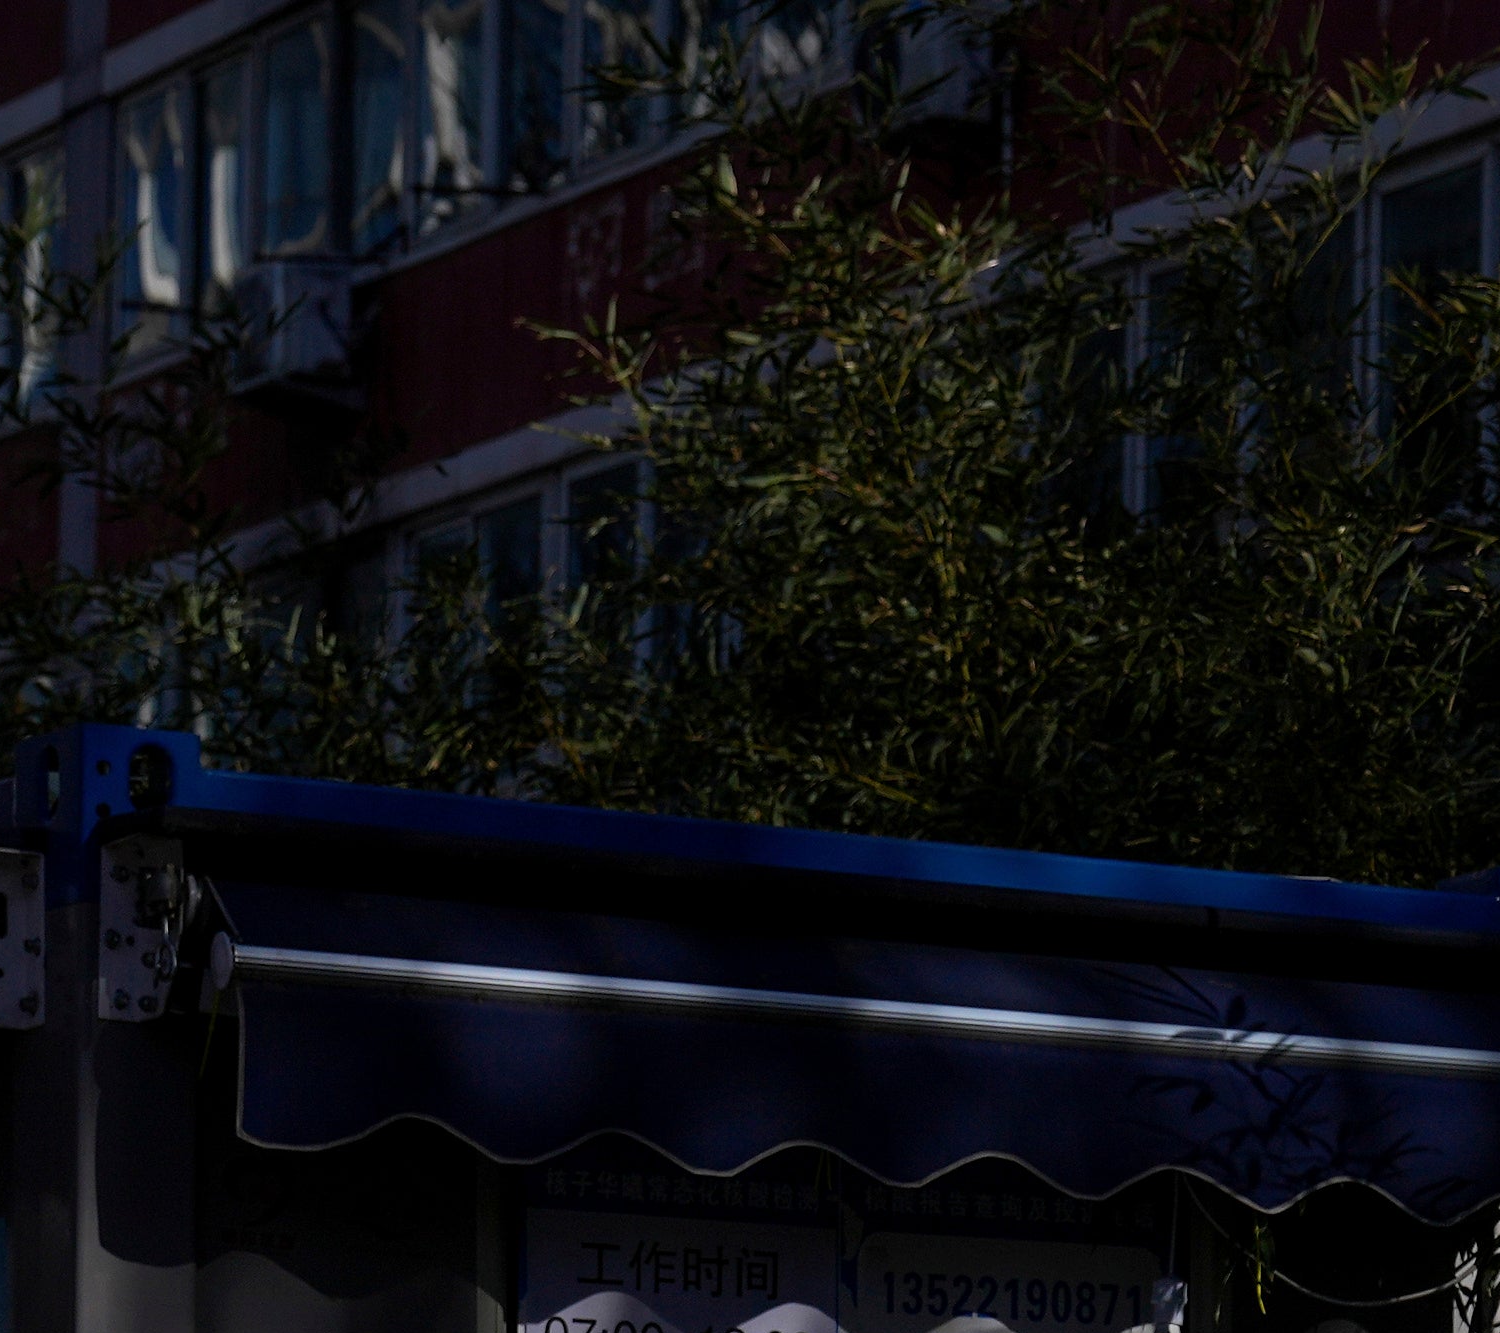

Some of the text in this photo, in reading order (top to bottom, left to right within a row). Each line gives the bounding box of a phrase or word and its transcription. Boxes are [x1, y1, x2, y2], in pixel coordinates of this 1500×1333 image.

[577, 1241, 780, 1300] 工作时间
[883, 1270, 1143, 1328] 13522190871
